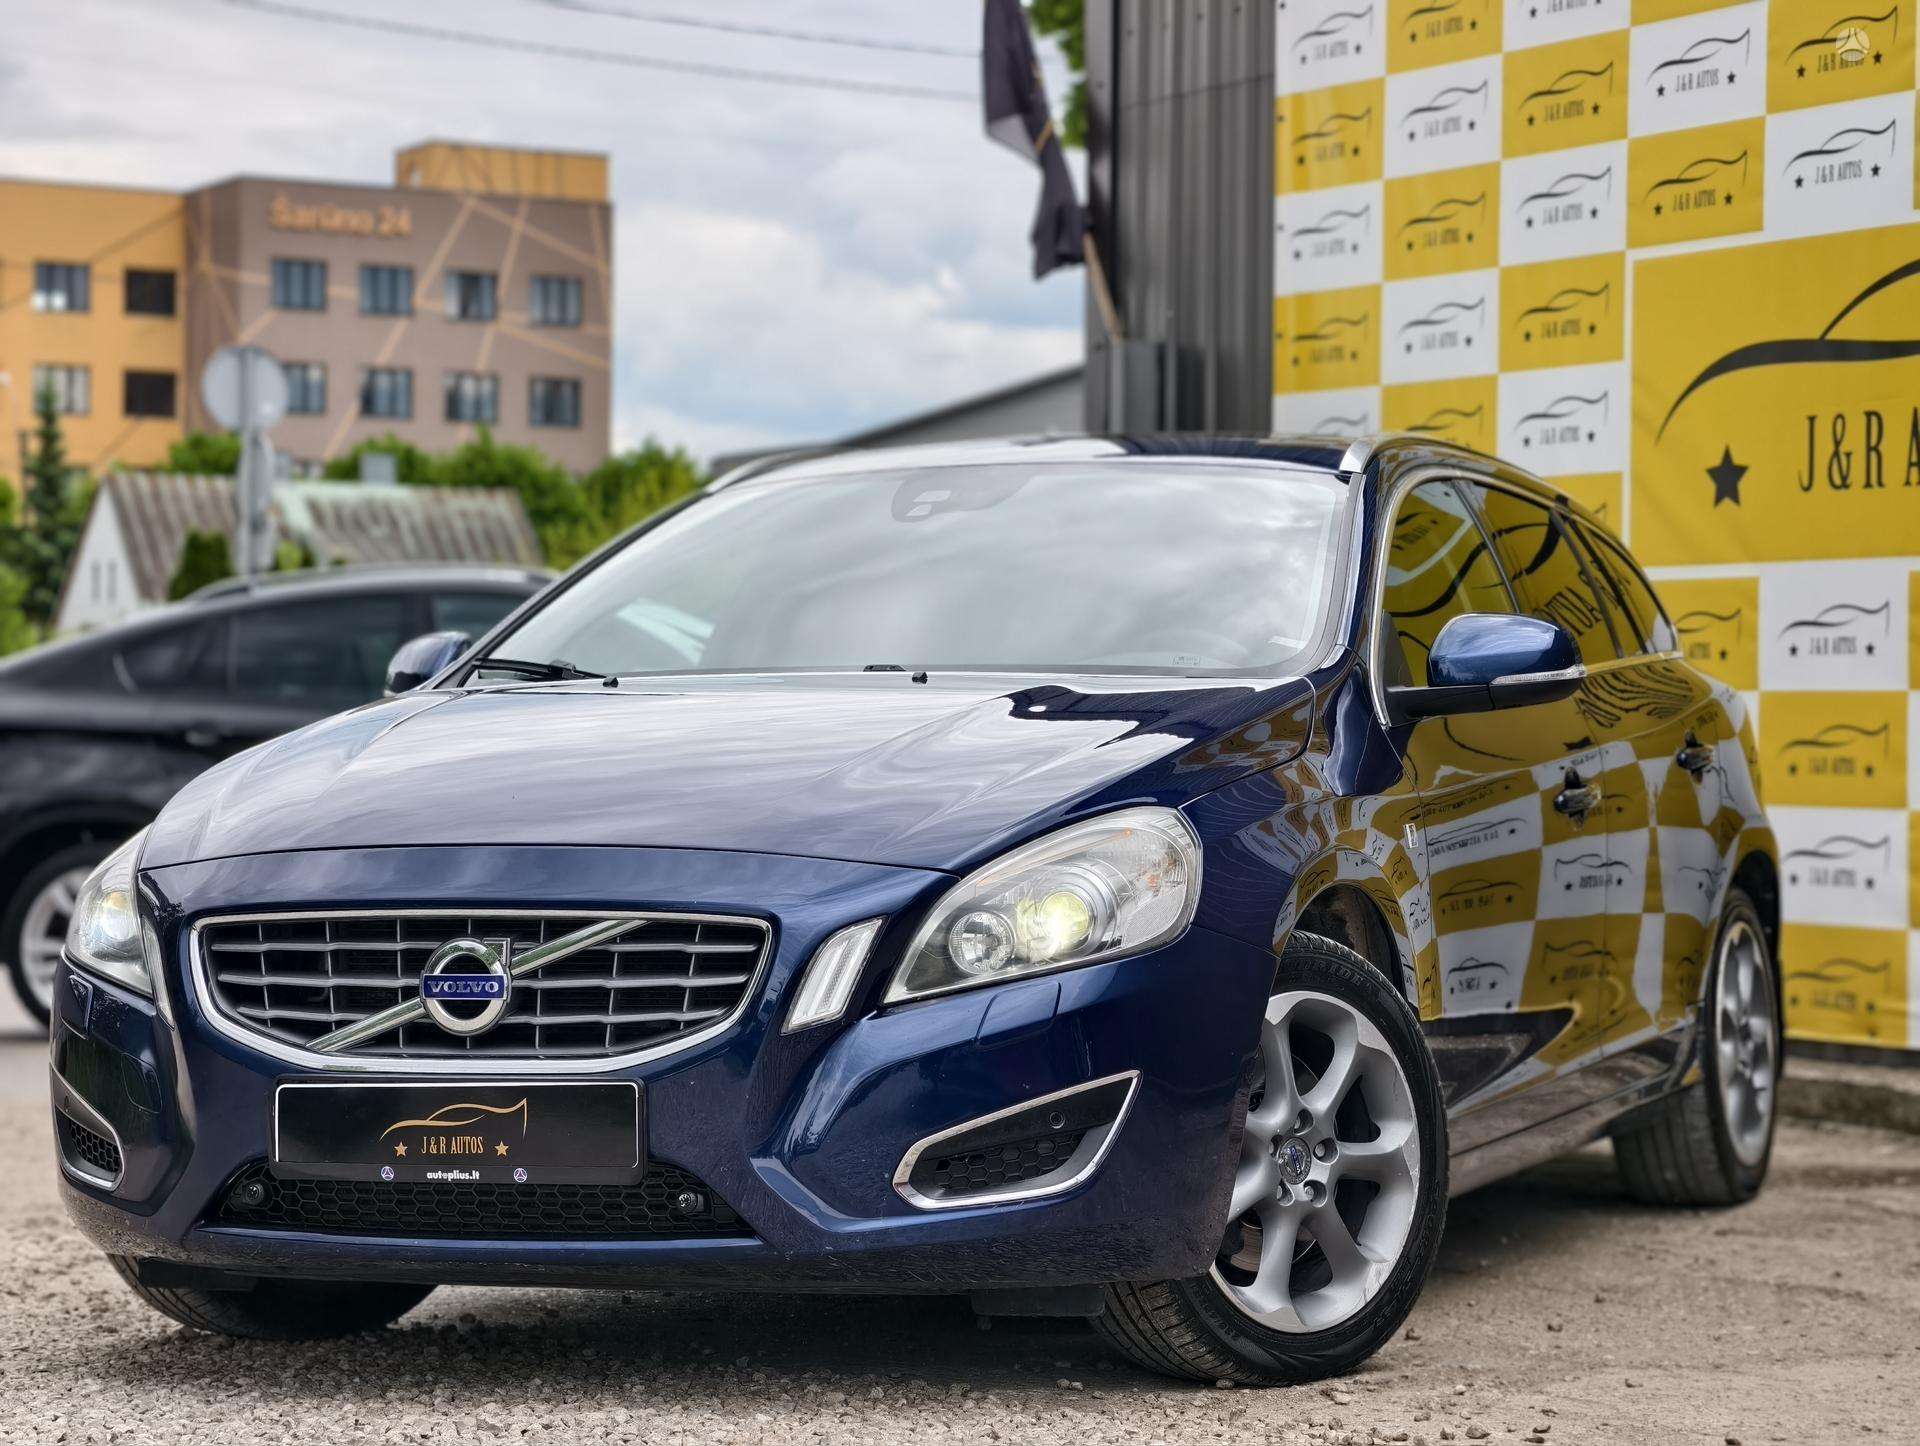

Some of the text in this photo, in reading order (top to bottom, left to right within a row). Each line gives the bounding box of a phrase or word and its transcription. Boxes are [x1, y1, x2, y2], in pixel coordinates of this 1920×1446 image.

[1696, 68, 1719, 89] AUTOS
[1837, 160, 1862, 181] AUTOS
[428, 981, 499, 993] VOLVO
[450, 1136, 484, 1154] AUTOS
[426, 1169, 480, 1181] autoplius.lt
